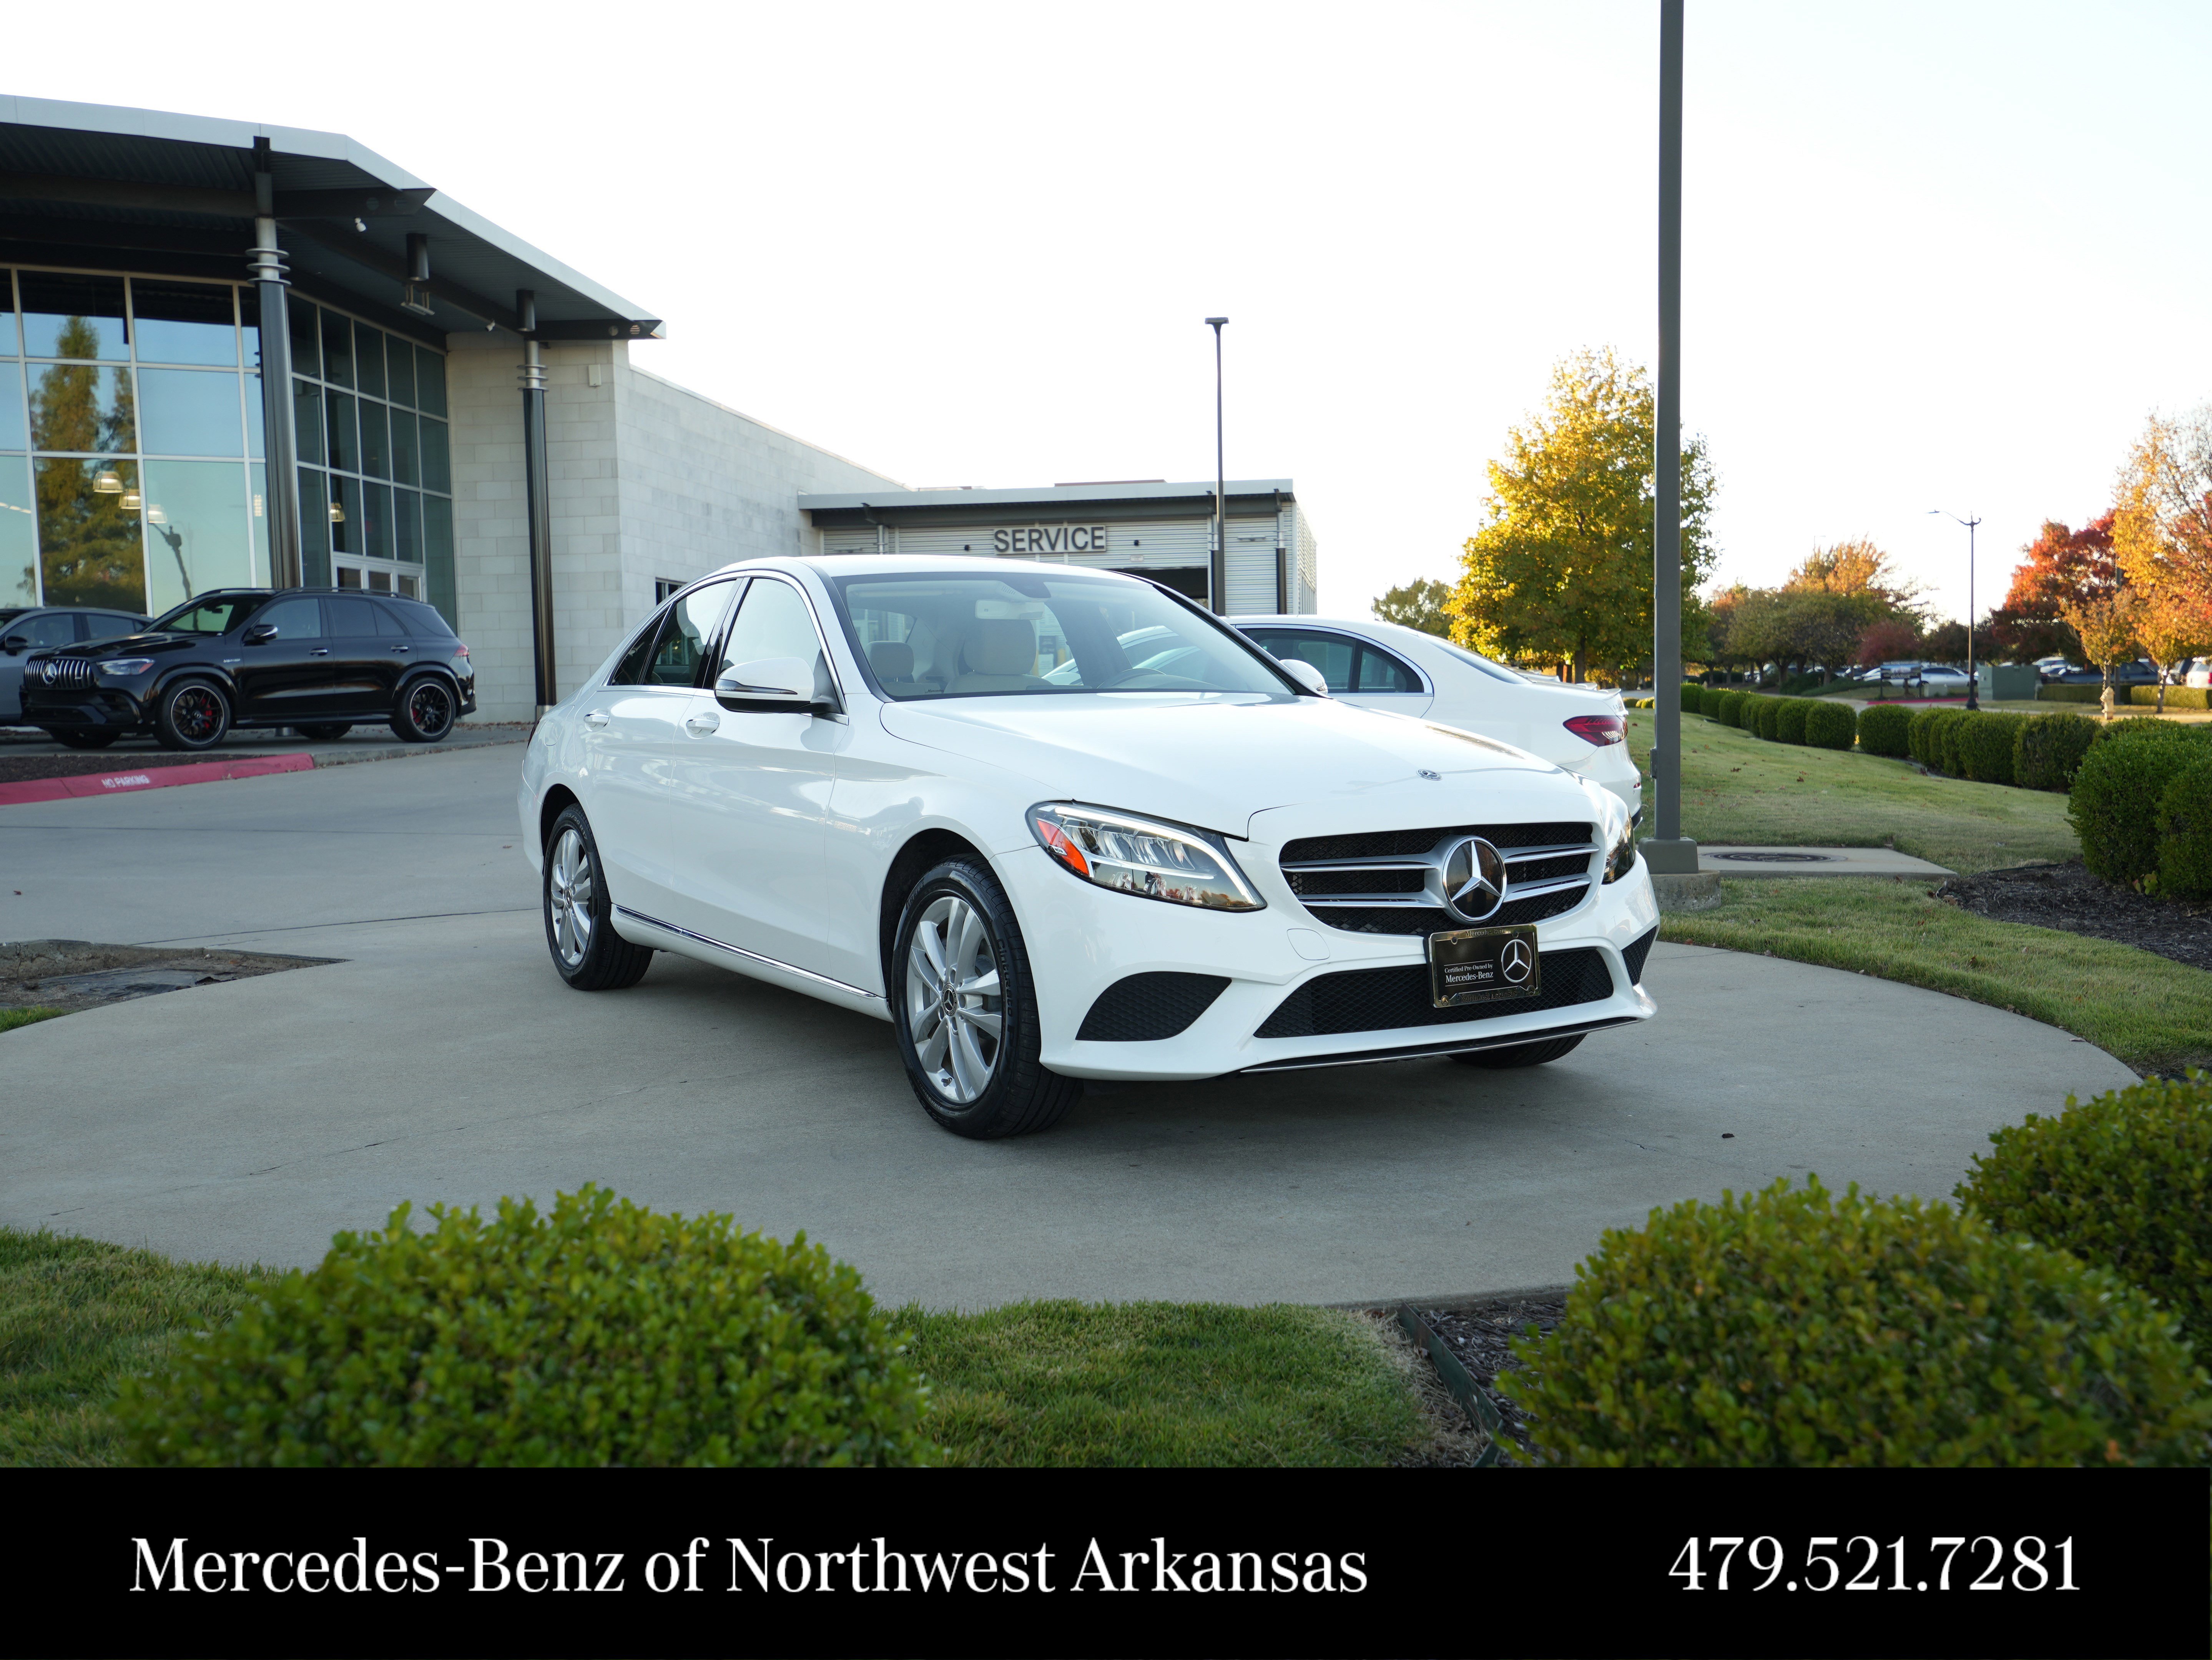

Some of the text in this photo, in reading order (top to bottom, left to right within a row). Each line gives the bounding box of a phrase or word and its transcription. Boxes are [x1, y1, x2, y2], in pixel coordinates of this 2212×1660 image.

[994, 526, 1105, 553] SERVICE
[101, 774, 150, 789] NO PARKING
[1464, 963, 1487, 971] Pre-Owned
[997, 938, 1013, 1017] Cinturato
[1446, 971, 1494, 983] Mercedes-Benz
[1461, 991, 1517, 1002] Northwest Arkansas
